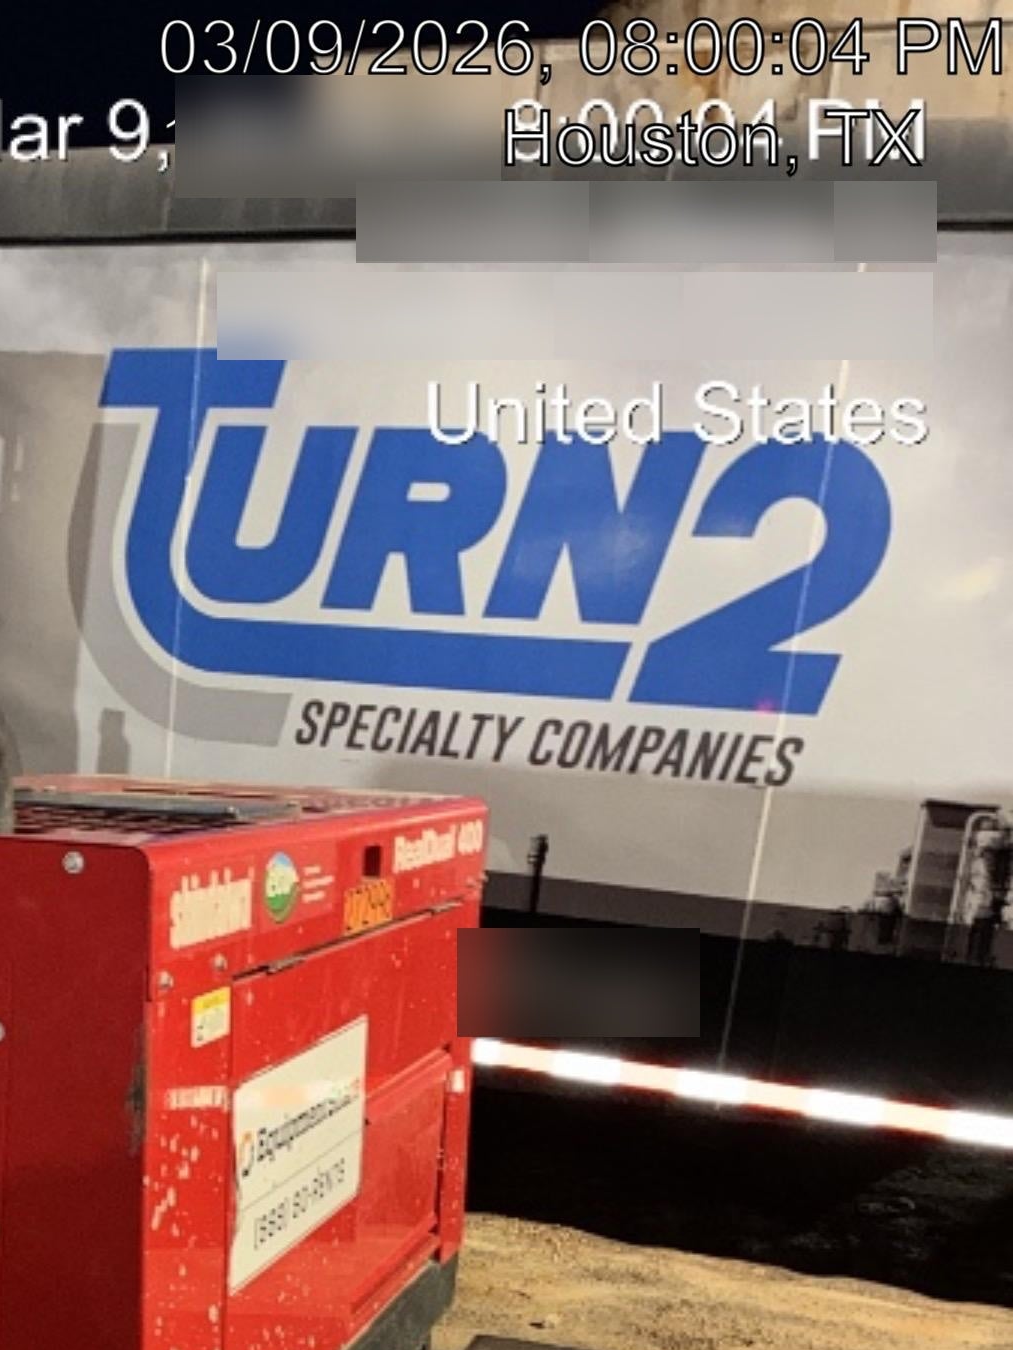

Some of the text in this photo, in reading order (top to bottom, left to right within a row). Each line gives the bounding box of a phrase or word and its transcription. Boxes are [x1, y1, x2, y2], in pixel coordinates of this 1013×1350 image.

[99, 347, 893, 716] TURN2
[294, 700, 806, 789] SPECIALTY COMPANIES
